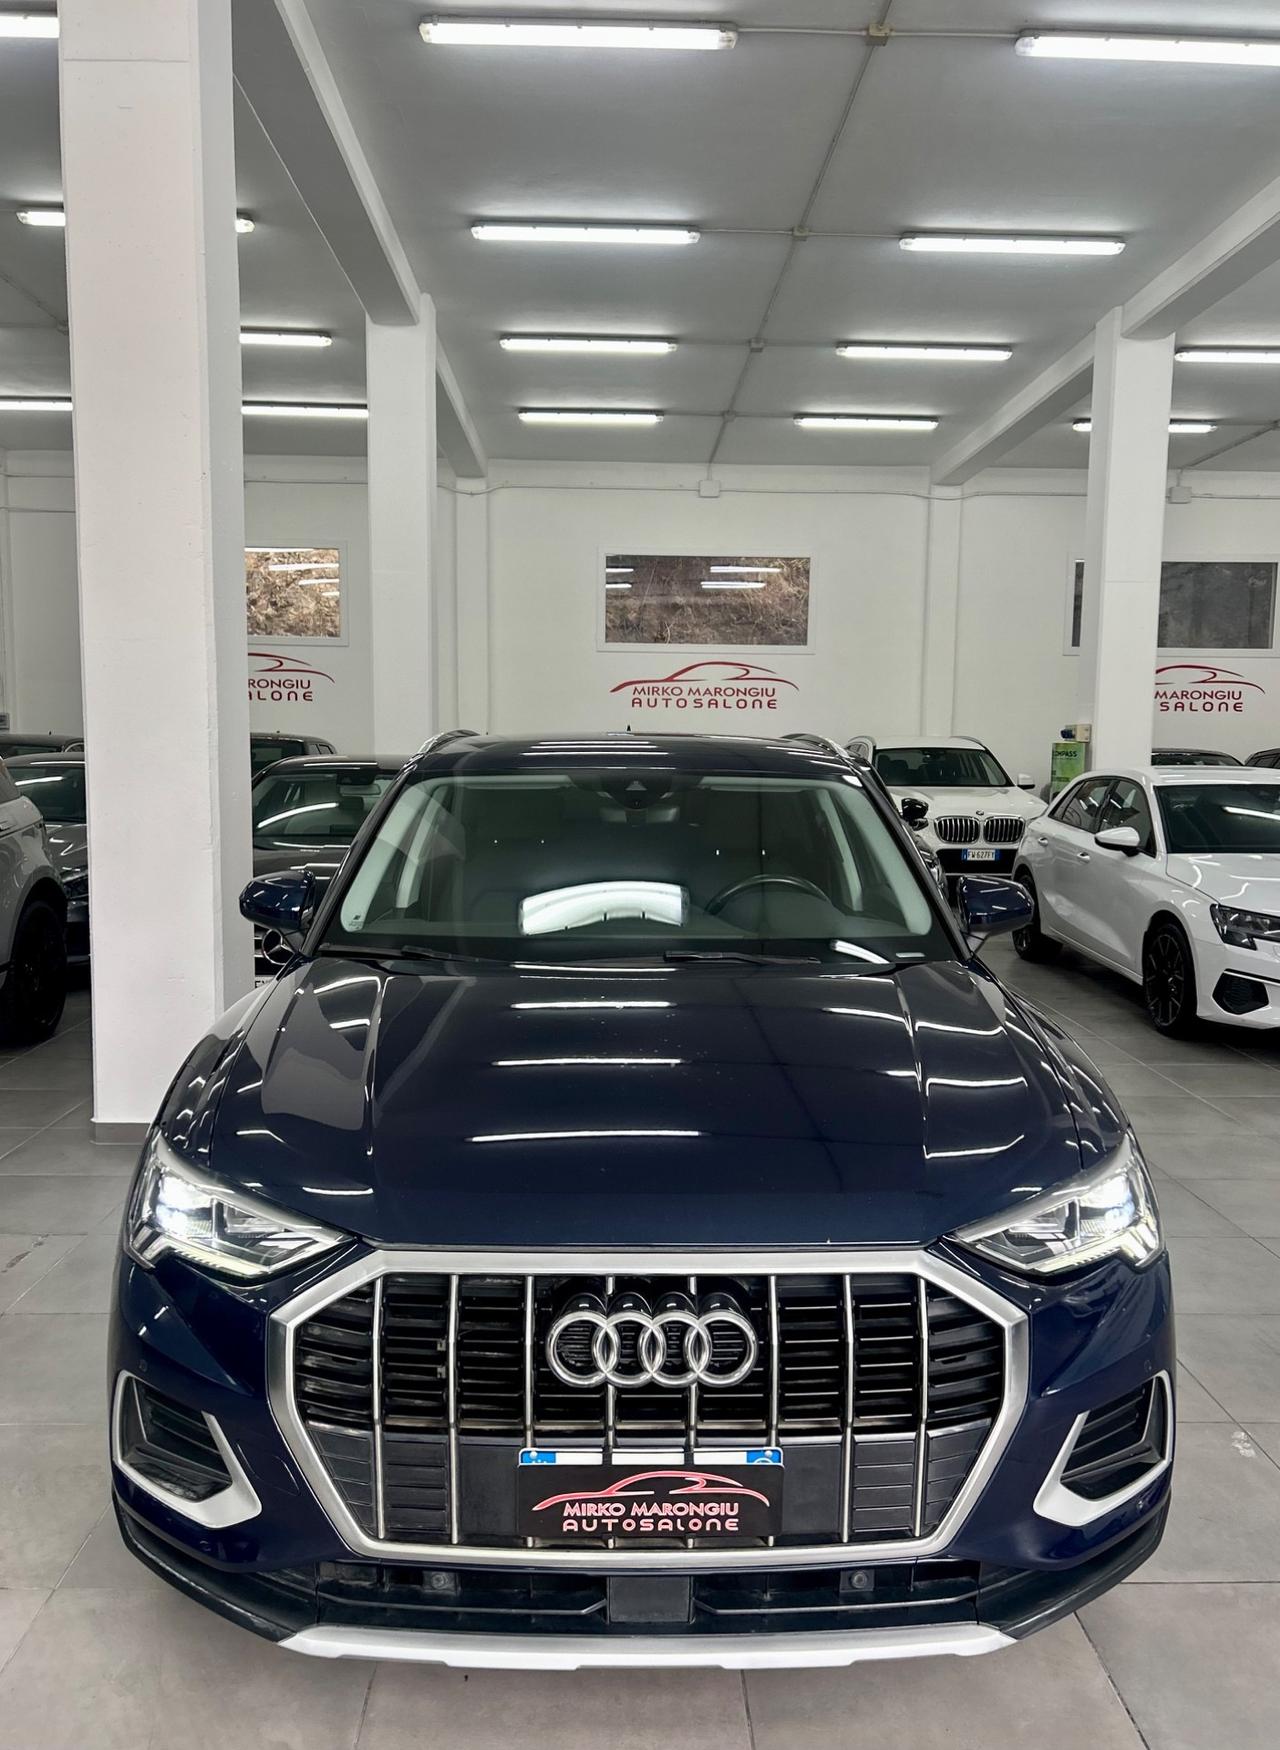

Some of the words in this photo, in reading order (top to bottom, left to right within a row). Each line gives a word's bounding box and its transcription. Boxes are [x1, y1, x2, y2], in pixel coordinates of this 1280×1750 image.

[632, 686, 683, 697] MIRKO
[687, 687, 776, 698] MARONGIU
[1154, 690, 1242, 701] MARONGIU
[632, 698, 777, 710] AUTOSALONE
[1160, 701, 1244, 713] SALONE
[563, 1502, 626, 1517] MIRKO
[631, 1502, 739, 1517] MARONGIU
[562, 1518, 739, 1532] AUTOSALONE
